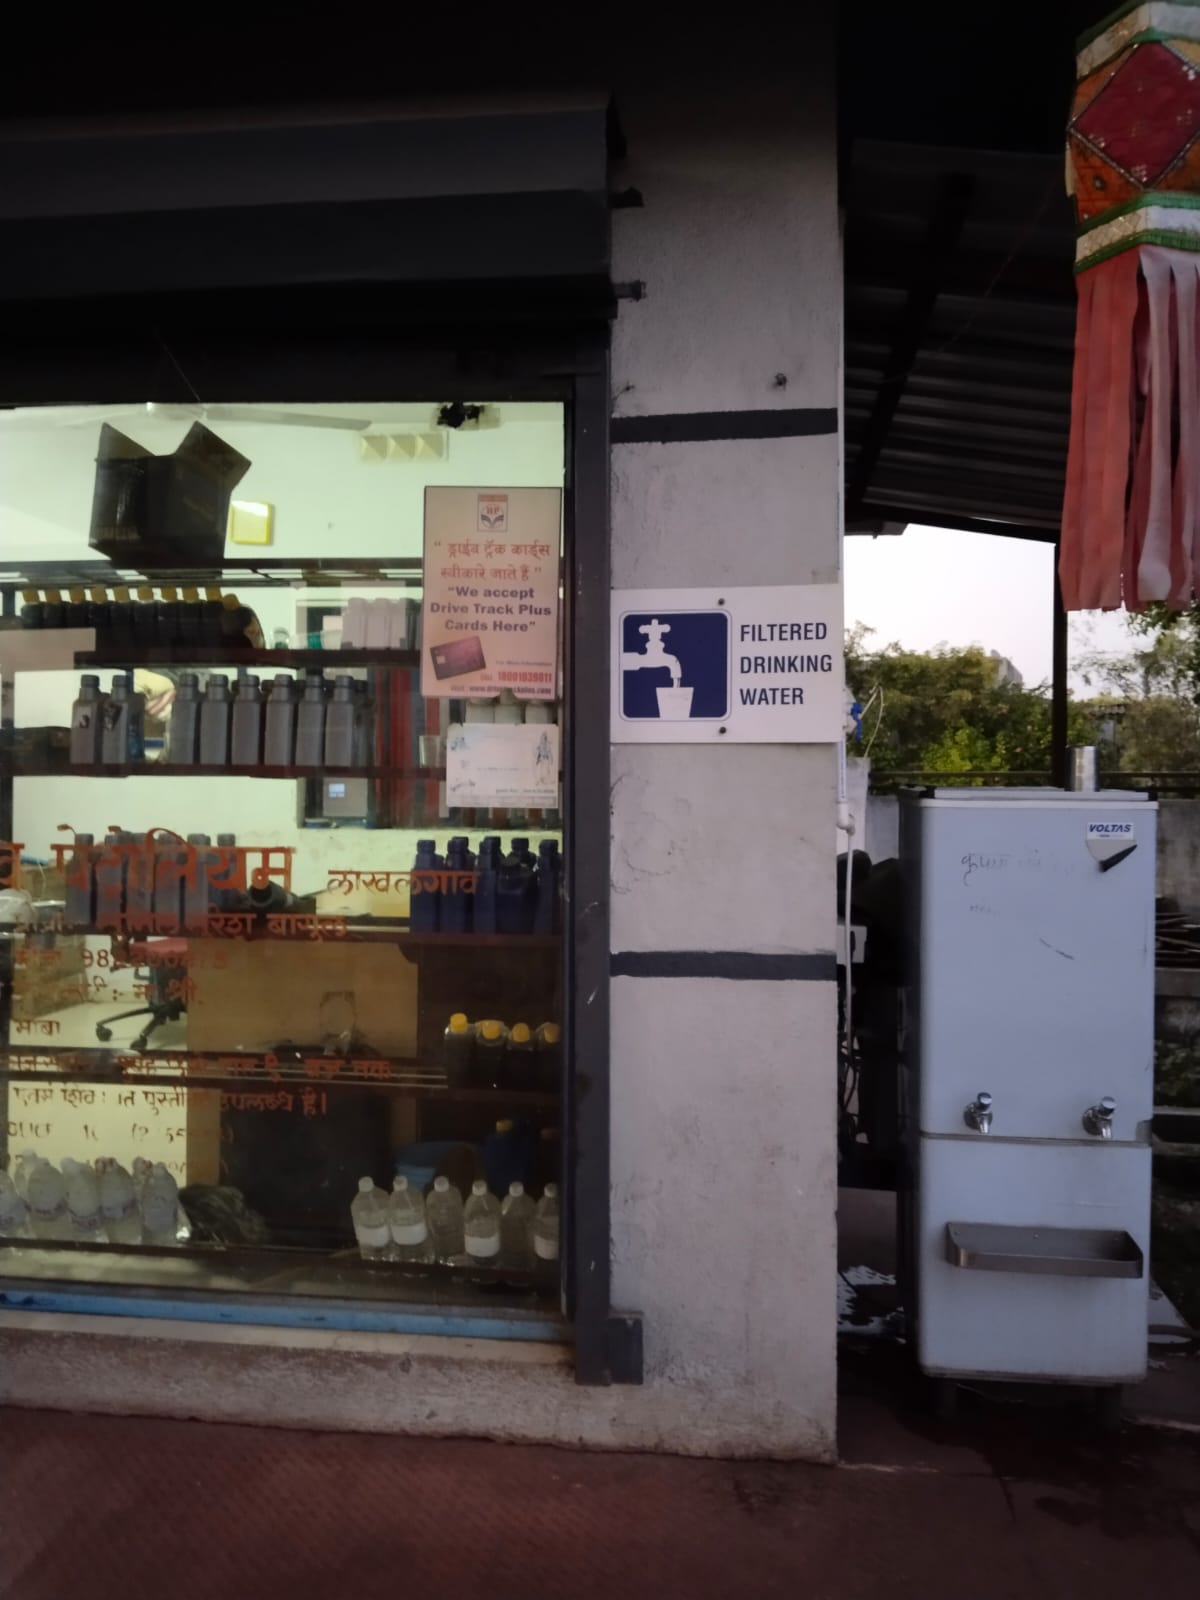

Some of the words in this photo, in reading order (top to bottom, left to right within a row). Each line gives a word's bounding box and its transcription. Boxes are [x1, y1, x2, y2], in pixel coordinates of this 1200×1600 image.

[483, 587, 535, 600] accept
[430, 602, 469, 613] Drive
[473, 603, 514, 614] Track
[518, 604, 552, 615] Plus
[444, 619, 488, 630] Cards
[740, 622, 828, 642] FILTERED
[740, 654, 833, 674] DRINKING
[740, 687, 805, 706] WATER
[1089, 823, 1132, 833] VOLTAS
